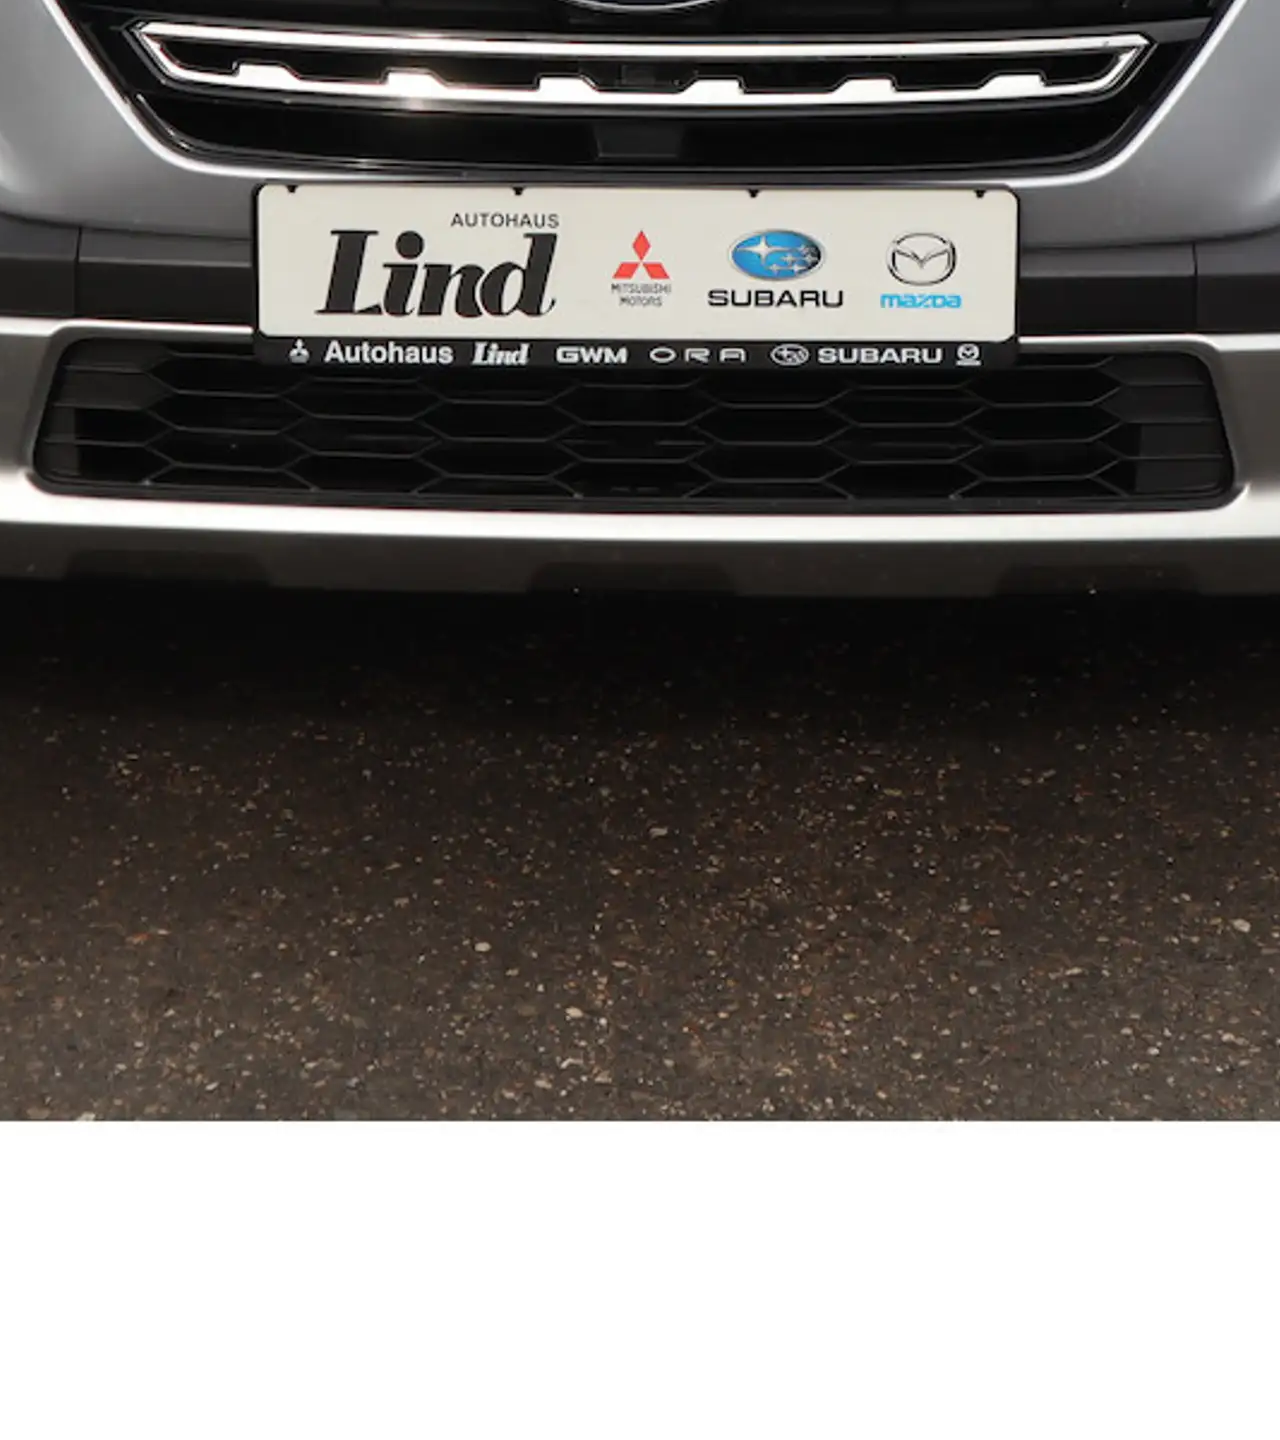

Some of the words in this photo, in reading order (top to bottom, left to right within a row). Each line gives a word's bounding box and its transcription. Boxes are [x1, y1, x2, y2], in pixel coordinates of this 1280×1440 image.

[450, 212, 560, 229] AUTOHAUS
[316, 229, 558, 318] Lind
[611, 283, 672, 296] MITSUBISHI
[619, 296, 663, 308] MOTORS
[708, 289, 844, 308] SUBARU
[880, 293, 962, 309] mazda
[324, 340, 454, 364] Autohaus
[472, 341, 530, 366] Lind
[556, 347, 628, 364] GWM
[818, 347, 942, 364] SUBARU
